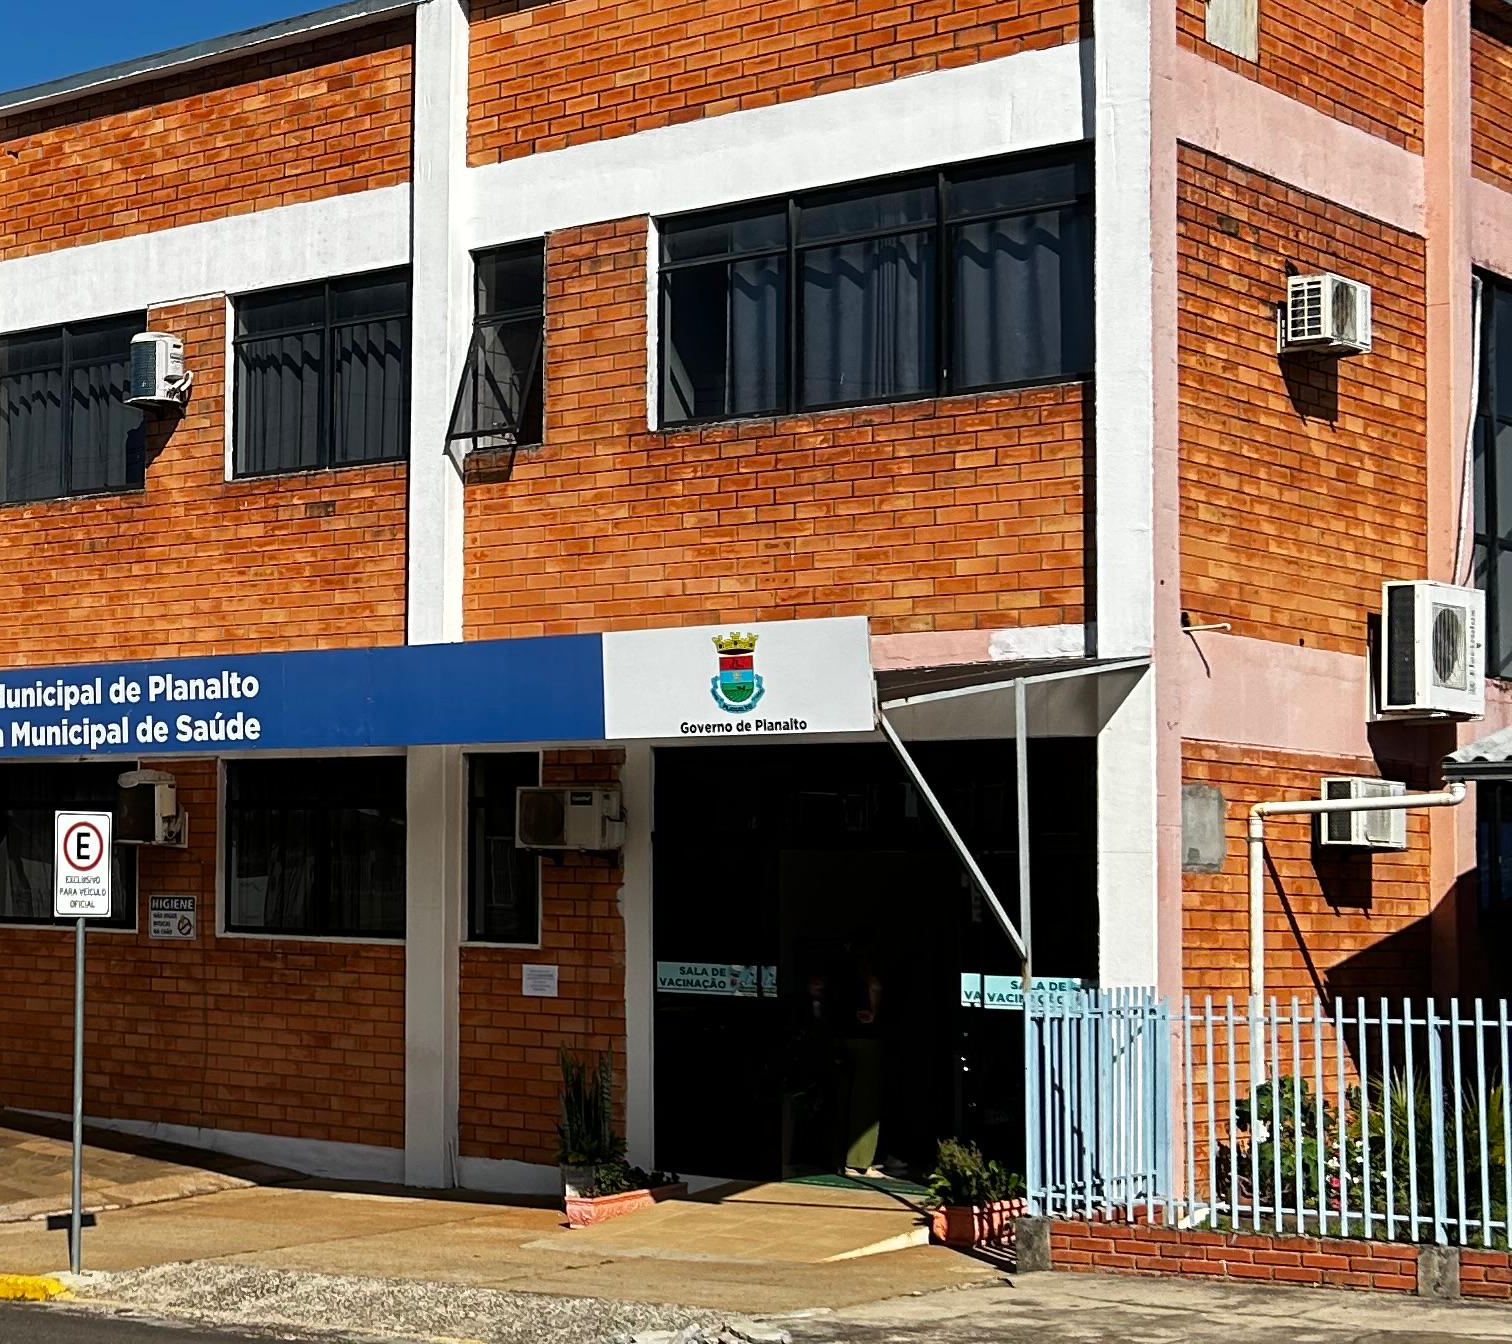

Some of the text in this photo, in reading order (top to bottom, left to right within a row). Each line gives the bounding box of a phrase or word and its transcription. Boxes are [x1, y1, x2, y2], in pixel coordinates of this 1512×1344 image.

[109, 676, 142, 704] de
[148, 670, 260, 702] Planalto
[11, 716, 129, 750] Municipal
[136, 715, 169, 743] de
[175, 711, 261, 742] Saúde
[680, 717, 808, 735] Governo de Planalto
[77, 832, 90, 860] E
[59, 887, 78, 896] PARA
[69, 899, 96, 909] OFICIAL
[152, 898, 194, 910] HIGIENE
[679, 966, 727, 977] SALA DE
[659, 976, 727, 990] VACINAÇÃO
[1010, 980, 1067, 992] SLA DE
